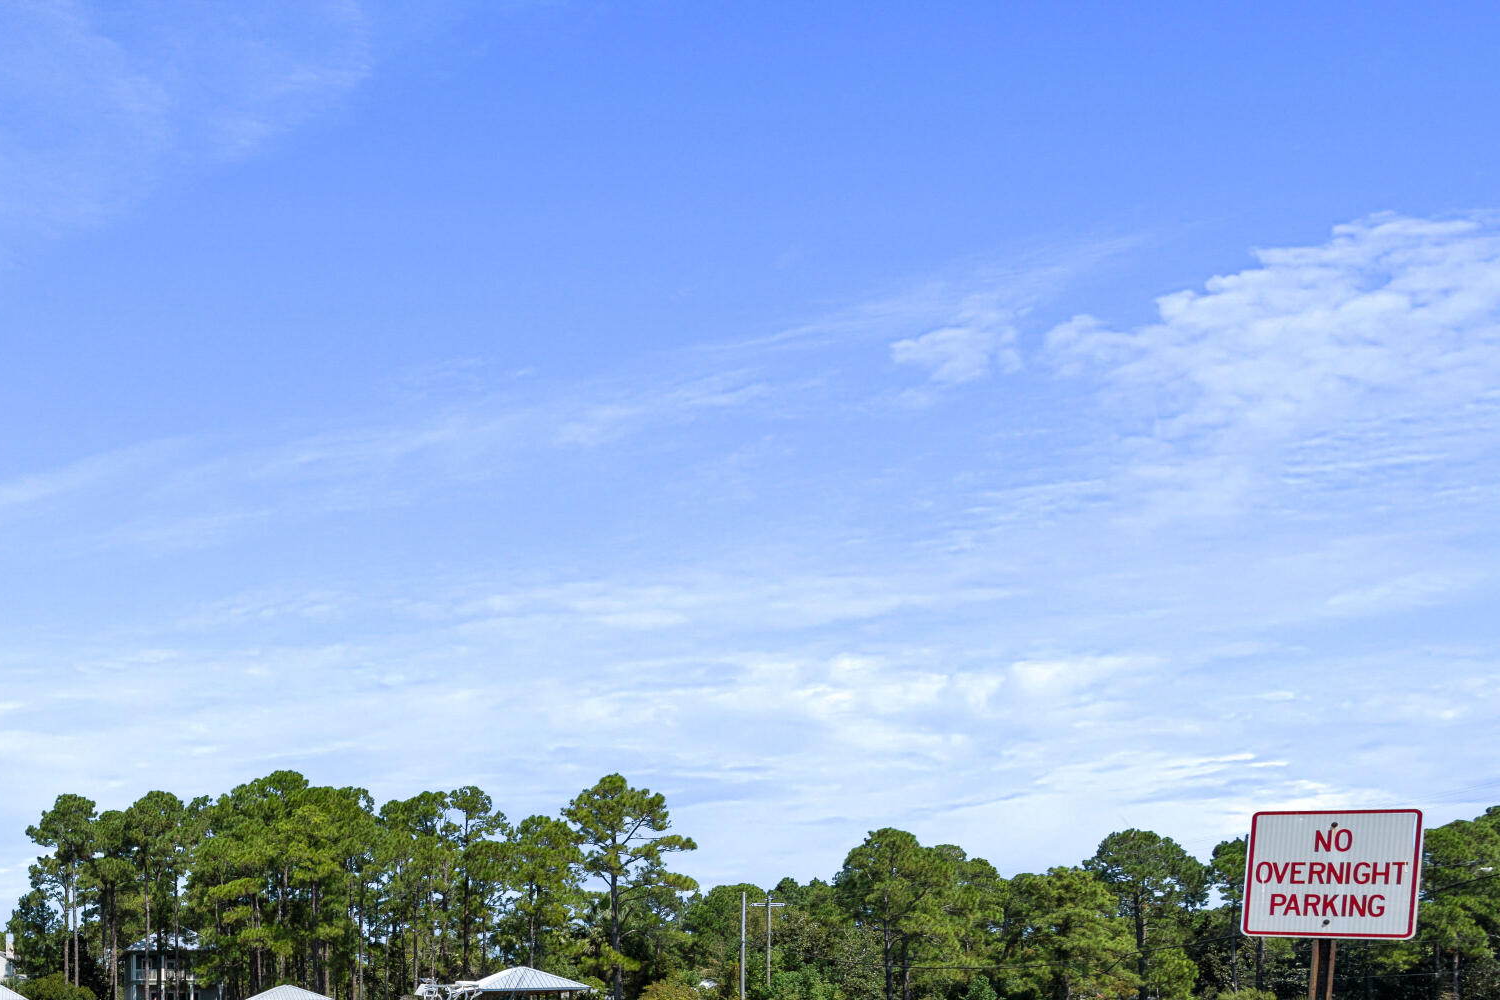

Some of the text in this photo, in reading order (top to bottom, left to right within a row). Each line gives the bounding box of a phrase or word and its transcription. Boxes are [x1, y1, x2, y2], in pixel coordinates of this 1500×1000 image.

[1313, 828, 1353, 853] NO
[1255, 861, 1409, 885] OVERNIGHT
[1269, 893, 1386, 918] PARKING
